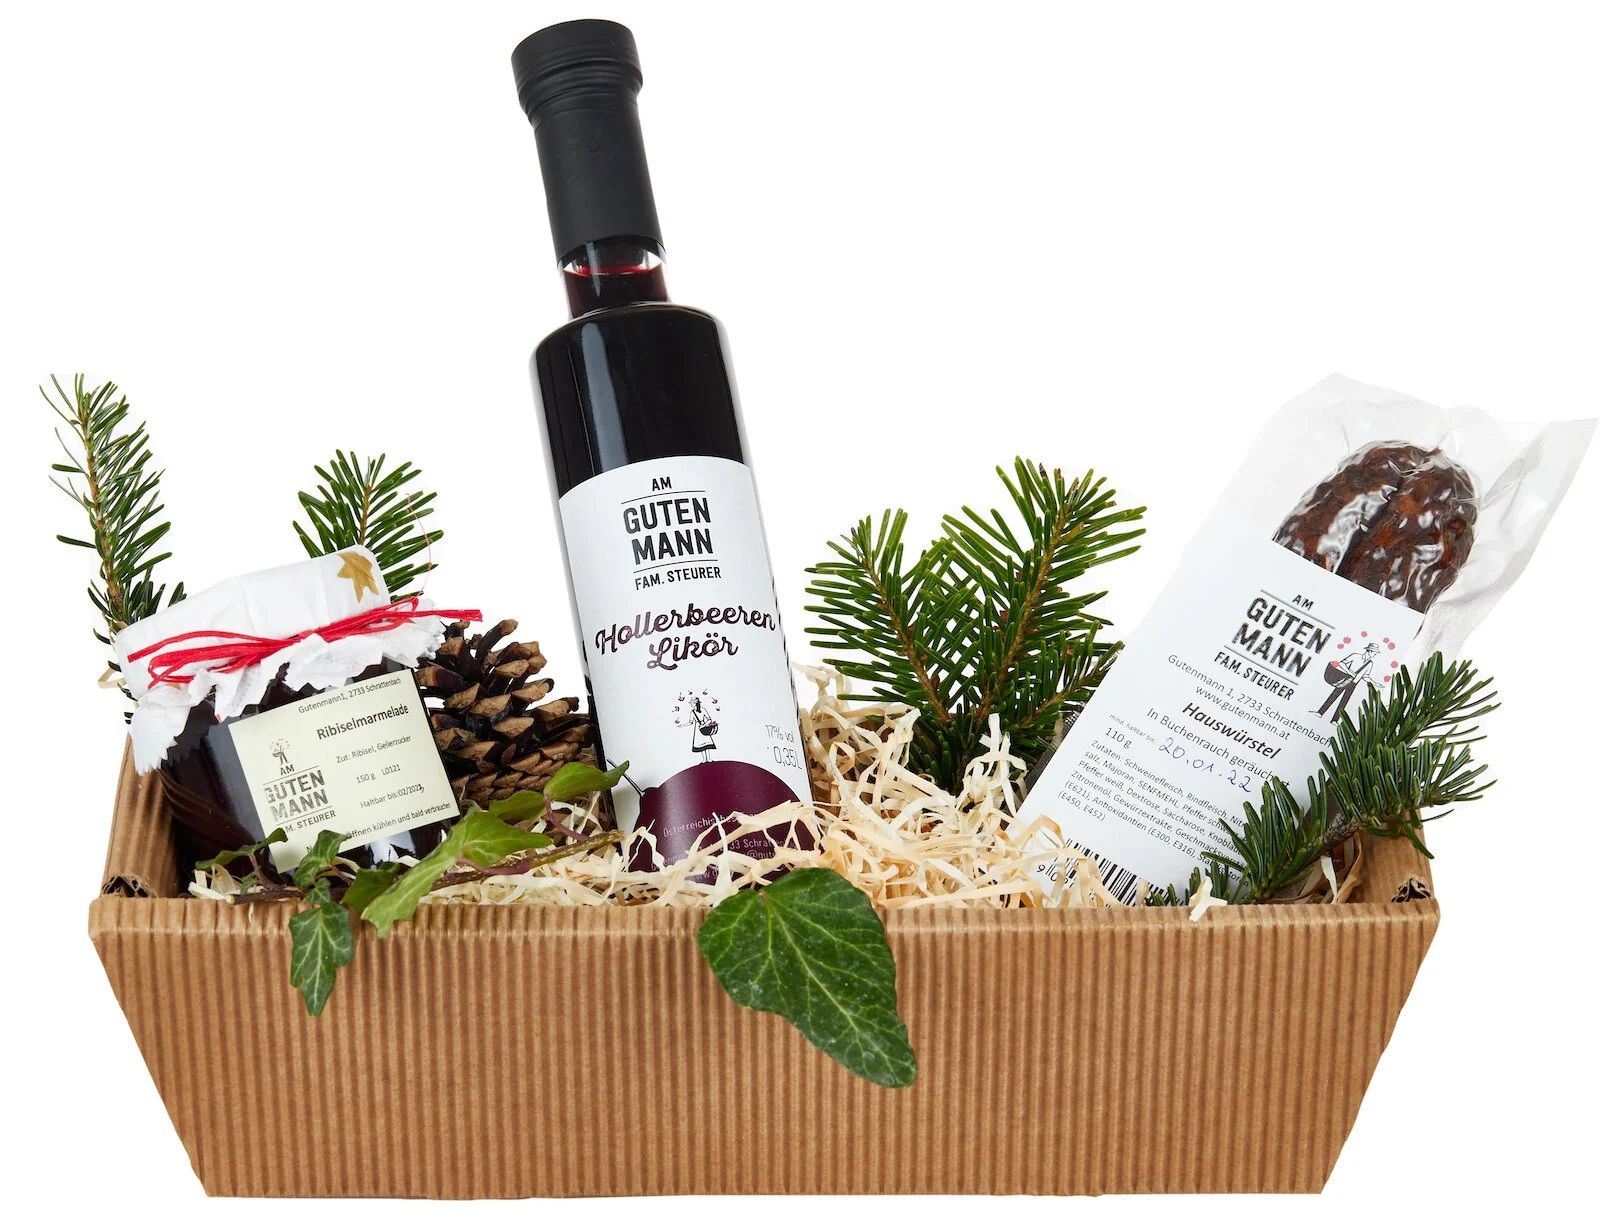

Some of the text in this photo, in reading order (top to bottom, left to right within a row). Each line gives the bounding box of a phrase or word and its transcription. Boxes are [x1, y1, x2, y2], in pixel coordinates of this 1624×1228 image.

[652, 476, 672, 491] AM
[623, 498, 711, 534] GUTEN
[631, 528, 714, 565] MANN
[635, 566, 721, 590] FAM. STEURER
[1292, 593, 1314, 611] AM
[595, 603, 776, 656] Hollerbeeren
[1247, 597, 1332, 655] GUTEN
[647, 632, 739, 671] Likör
[1231, 622, 1313, 678] MANN
[348, 686, 366, 698] 2733
[365, 678, 401, 693] Schrattenbach
[1214, 651, 1295, 700] FAM. STEURER
[1168, 654, 1331, 748] Gutenmann 1, 2733 Schrattenbach
[1196, 686, 1290, 740] www.gutenmann.at
[316, 704, 409, 740] Ribiselmarmelade
[765, 724, 784, 740] 17%
[1105, 727, 1132, 750] 110 g
[1109, 714, 1125, 725] mind.
[1125, 723, 1146, 737] haltbar
[1147, 708, 1159, 720] In
[1160, 715, 1230, 759] Buchenrauch
[1182, 702, 1282, 759] Hauswürstel
[336, 735, 411, 764] Zut: Ribisel, Gelierzucker
[774, 746, 803, 770] 0,35L
[1158, 736, 1252, 793] 20.01.22
[264, 770, 325, 804] GUTEN
[280, 764, 295, 775] AM
[356, 774, 370, 784] 150
[370, 773, 376, 781] g
[1085, 750, 1100, 765] salz,
[1102, 760, 1135, 785] Majoran,
[1138, 780, 1180, 809] SENFMEHL,
[1182, 804, 1207, 822] Pfeffer
[1091, 739, 1123, 763] Zutaten:
[1123, 758, 1184, 798] Schweinefleisch,
[1186, 792, 1228, 820] Rindfleisch,
[270, 789, 329, 822] MANN
[360, 794, 386, 808] Haltbar
[1057, 791, 1106, 822] (E450, E452)
[1064, 780, 1091, 801] (E621),
[1092, 796, 1147, 831] Antioxidantien
[1148, 827, 1171, 845] (E300,
[1172, 840, 1196, 858] E316),
[1071, 770, 1112, 798] Zitronenöl,
[1113, 794, 1173, 833] Gewürzextrakte,
[1105, 776, 1124, 792] weiß,
[1126, 788, 1161, 813] Dextrose,
[1162, 807, 1206, 836] Saccharose,
[297, 810, 336, 829] STEURER
[372, 817, 397, 830] kühlen
[397, 813, 411, 824] und
[411, 809, 424, 819] bald
